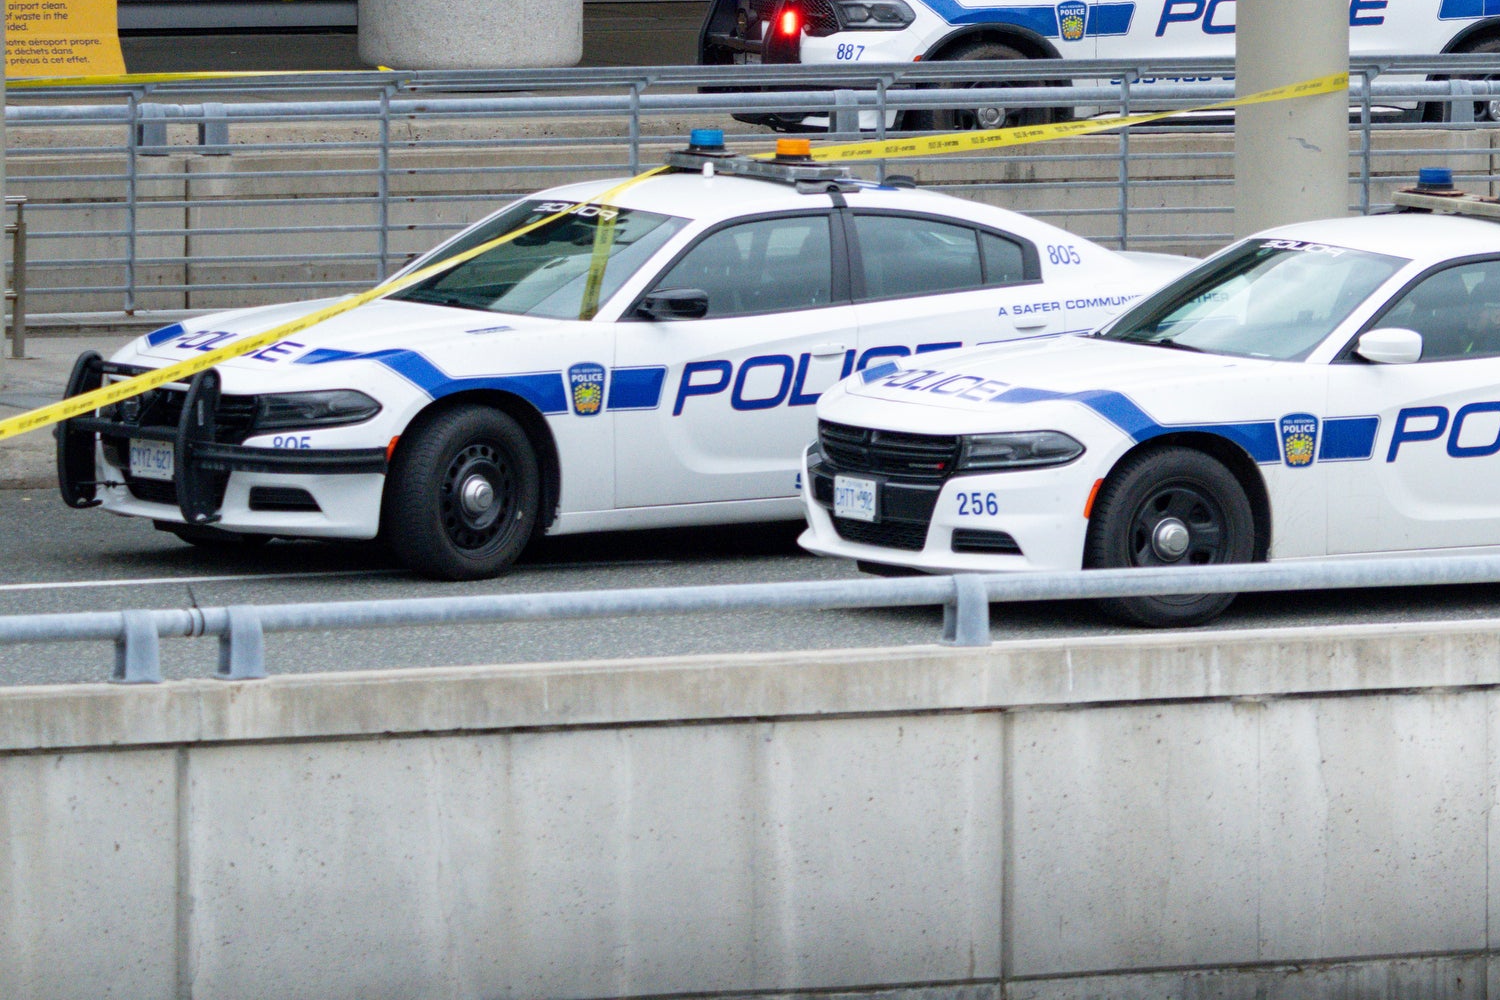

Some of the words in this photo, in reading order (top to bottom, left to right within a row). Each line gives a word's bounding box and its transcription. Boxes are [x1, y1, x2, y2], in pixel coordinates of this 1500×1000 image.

[8, 2, 39, 12] airport
[41, 1, 68, 10] clean.
[14, 13, 41, 21] waste
[43, 12, 52, 20] in
[53, 11, 69, 20] the
[1060, 8, 1086, 16] POLICE
[7, 22, 28, 31] ided.
[28, 38, 68, 47] aéroport
[70, 39, 102, 47] propre.
[14, 47, 50, 55] déchets
[51, 47, 74, 55] dans
[836, 43, 865, 61] 887
[10, 57, 41, 66] prévus
[42, 56, 49, 64] à
[50, 56, 65, 64] cet
[66, 56, 91, 64] effet.
[1046, 244, 1081, 265] 805
[998, 307, 1008, 317] A
[1012, 299, 1062, 315] SAFER
[1065, 294, 1143, 310] COMMUN
[571, 373, 603, 382] POLICE
[1283, 424, 1316, 434] POLICE
[272, 436, 312, 448] 805
[956, 492, 999, 516] 256
